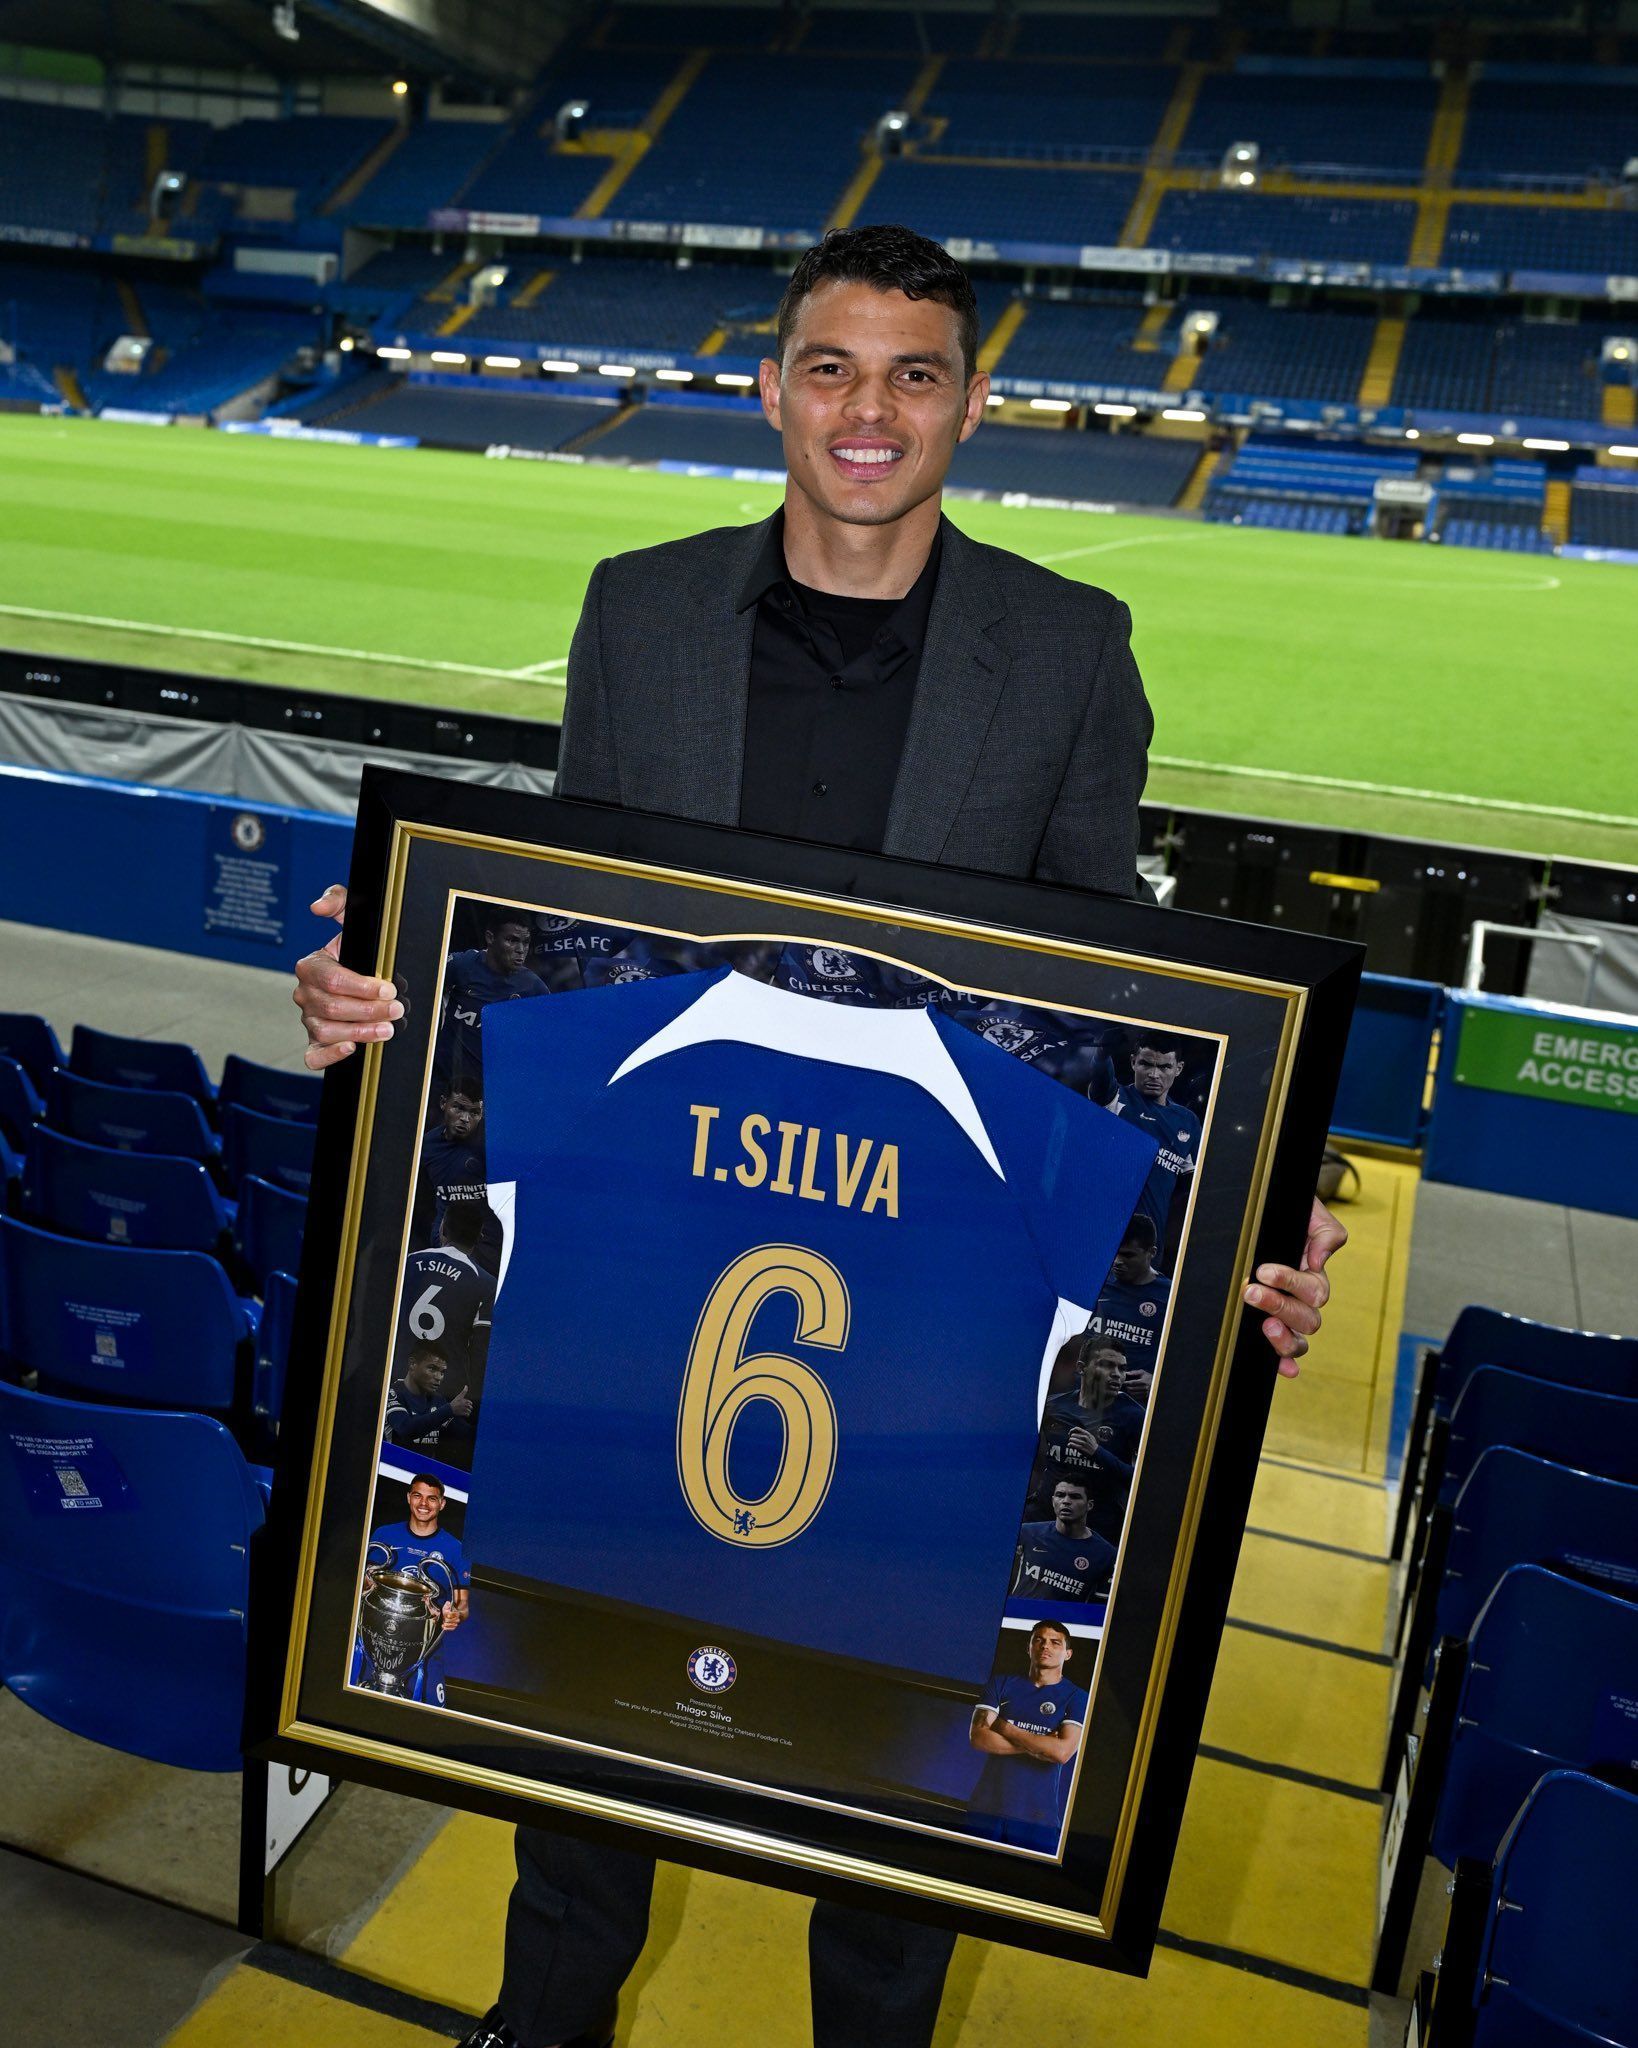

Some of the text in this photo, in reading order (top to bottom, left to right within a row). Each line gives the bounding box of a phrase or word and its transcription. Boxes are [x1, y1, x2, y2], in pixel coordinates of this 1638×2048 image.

[591, 936, 612, 951] FC
[788, 976, 866, 996] CHELSEA
[1517, 1059, 1638, 1099] ACCESS
[690, 1104, 899, 1219] T.SILVA
[449, 1191, 487, 1201] ATHLET
[409, 1284, 445, 1341] 6
[1104, 1328, 1152, 1346] ATHLETE
[1106, 1319, 1154, 1338] INFINITE
[676, 1242, 851, 1549] 6
[61, 1499, 76, 1508] NO
[1040, 1576, 1083, 1596] ATHLETE
[1043, 1568, 1085, 1590] INFINITE
[698, 1647, 730, 1662] CHELSEA
[436, 1683, 445, 1703] 6
[676, 1702, 732, 1723] Thiago Silva
[690, 1698, 716, 1709] Presented
[614, 1699, 630, 1707] Thank
[663, 1711, 694, 1723] outstanding
[695, 1719, 726, 1731] contribution
[734, 1727, 756, 1738] Chelsea
[757, 1732, 779, 1743] Football
[780, 1738, 793, 1746] Club
[670, 1719, 687, 1727] August
[709, 1728, 720, 1737] May
